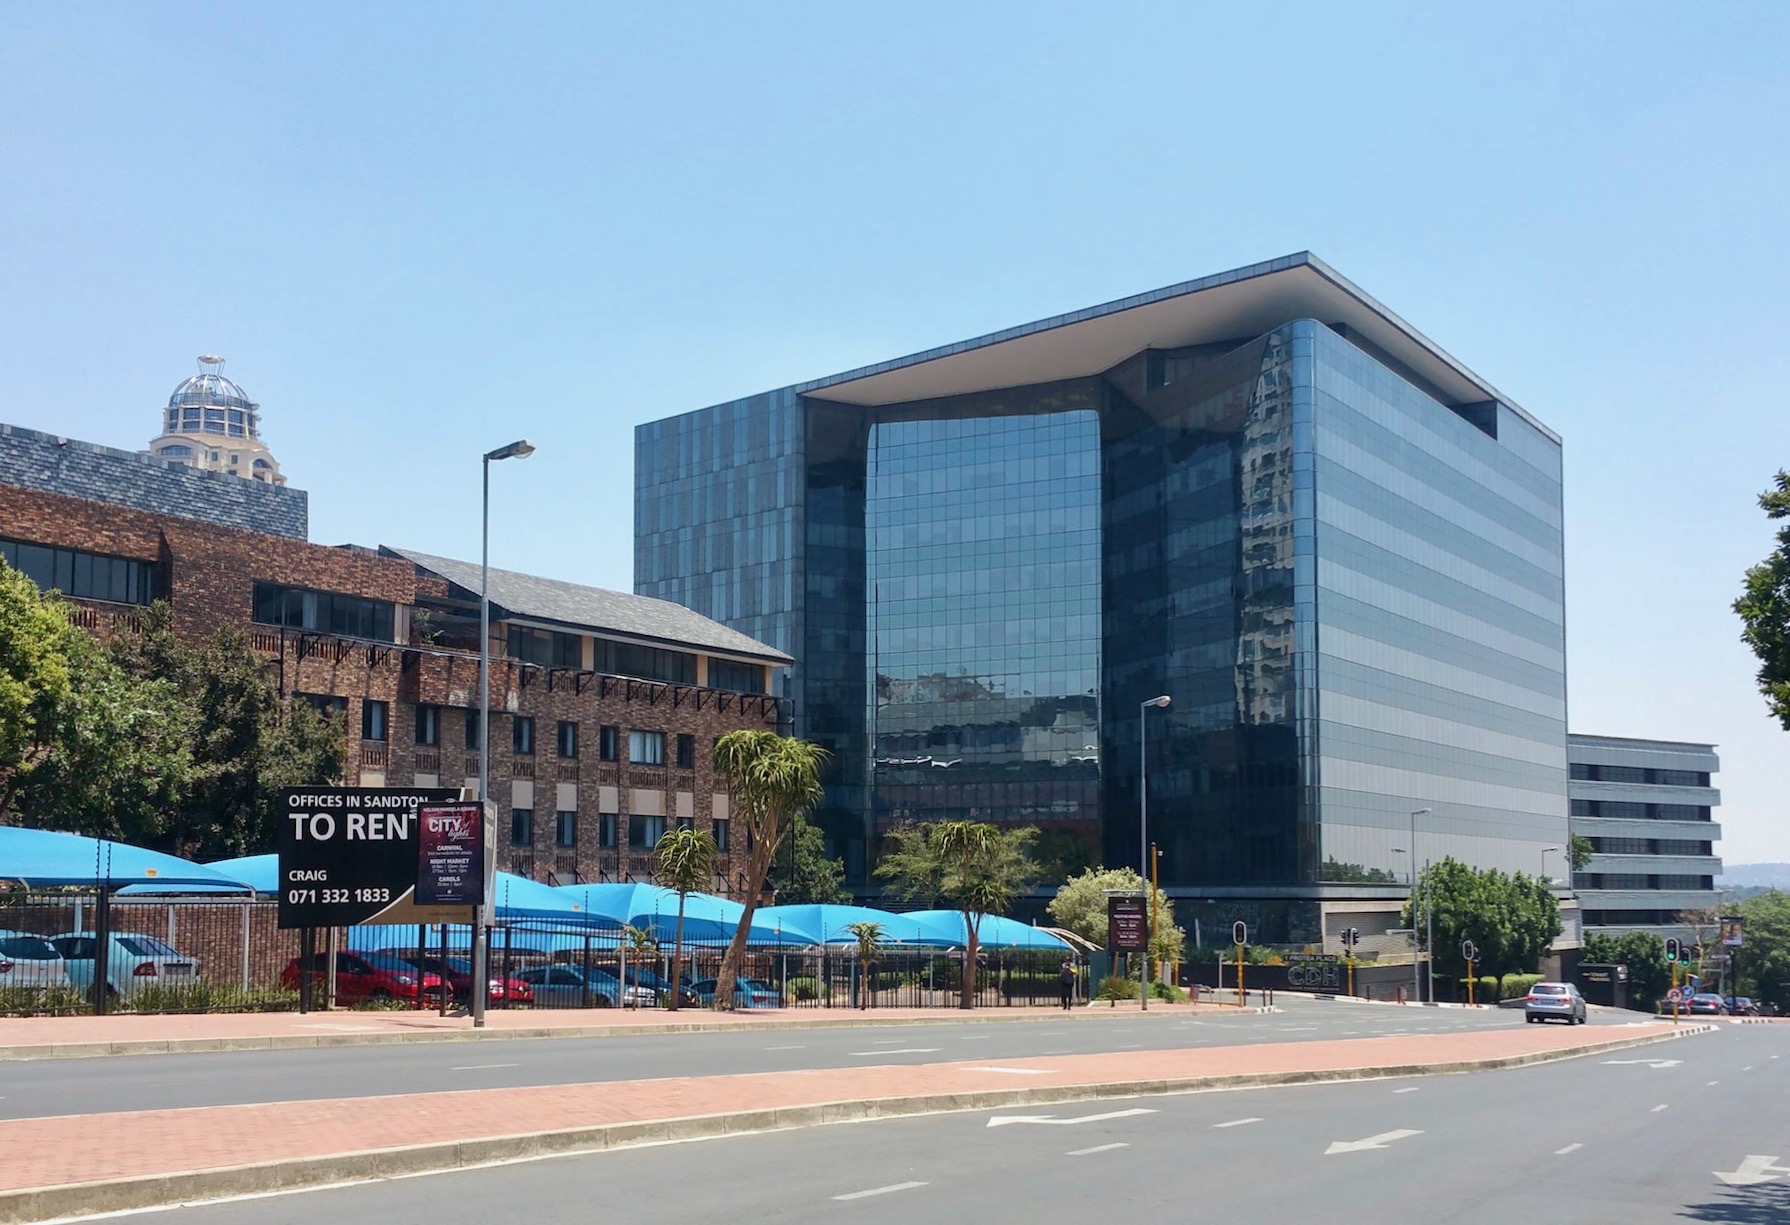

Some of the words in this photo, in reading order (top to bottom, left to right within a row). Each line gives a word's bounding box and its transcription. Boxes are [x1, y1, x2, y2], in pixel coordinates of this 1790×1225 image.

[288, 795, 343, 808] OFFICES
[346, 795, 361, 808] IN
[288, 812, 336, 840] TO
[428, 818, 462, 833] CITY
[288, 869, 327, 881] CRAIG
[288, 889, 316, 904] 071
[321, 888, 350, 903] 332
[354, 887, 390, 903] 1833
[1287, 966, 1339, 987] CDH
